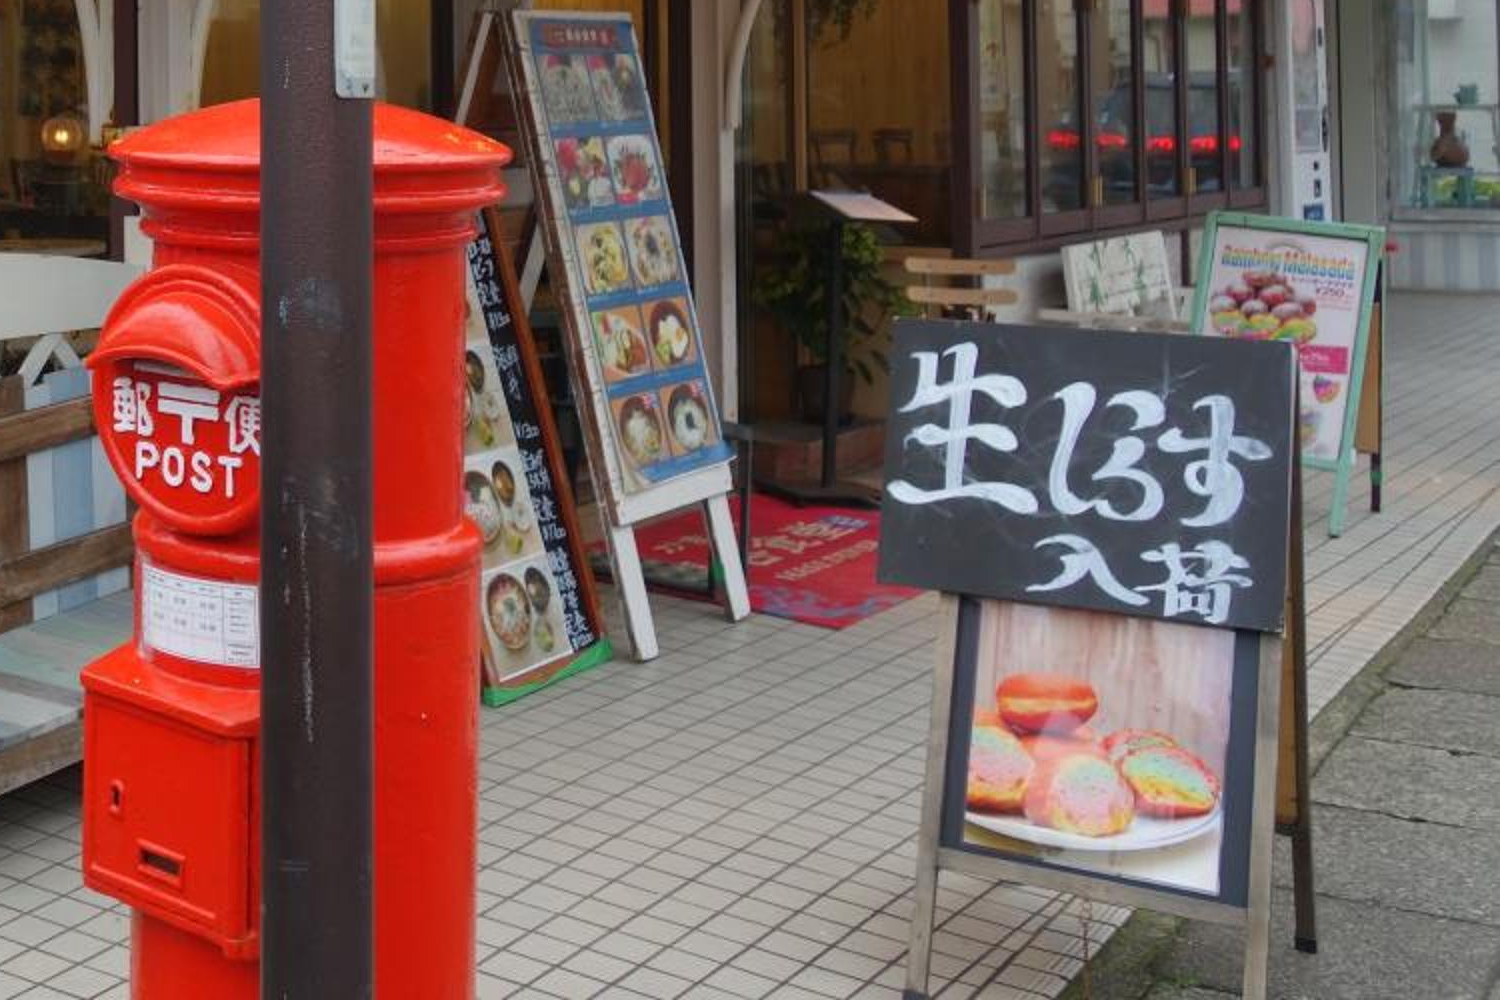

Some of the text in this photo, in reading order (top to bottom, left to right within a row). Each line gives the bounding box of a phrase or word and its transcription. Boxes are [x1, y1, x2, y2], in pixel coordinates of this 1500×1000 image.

[136, 442, 243, 499] POST
[887, 341, 1273, 528] 生しらす
[1025, 532, 1256, 625] 入荷
